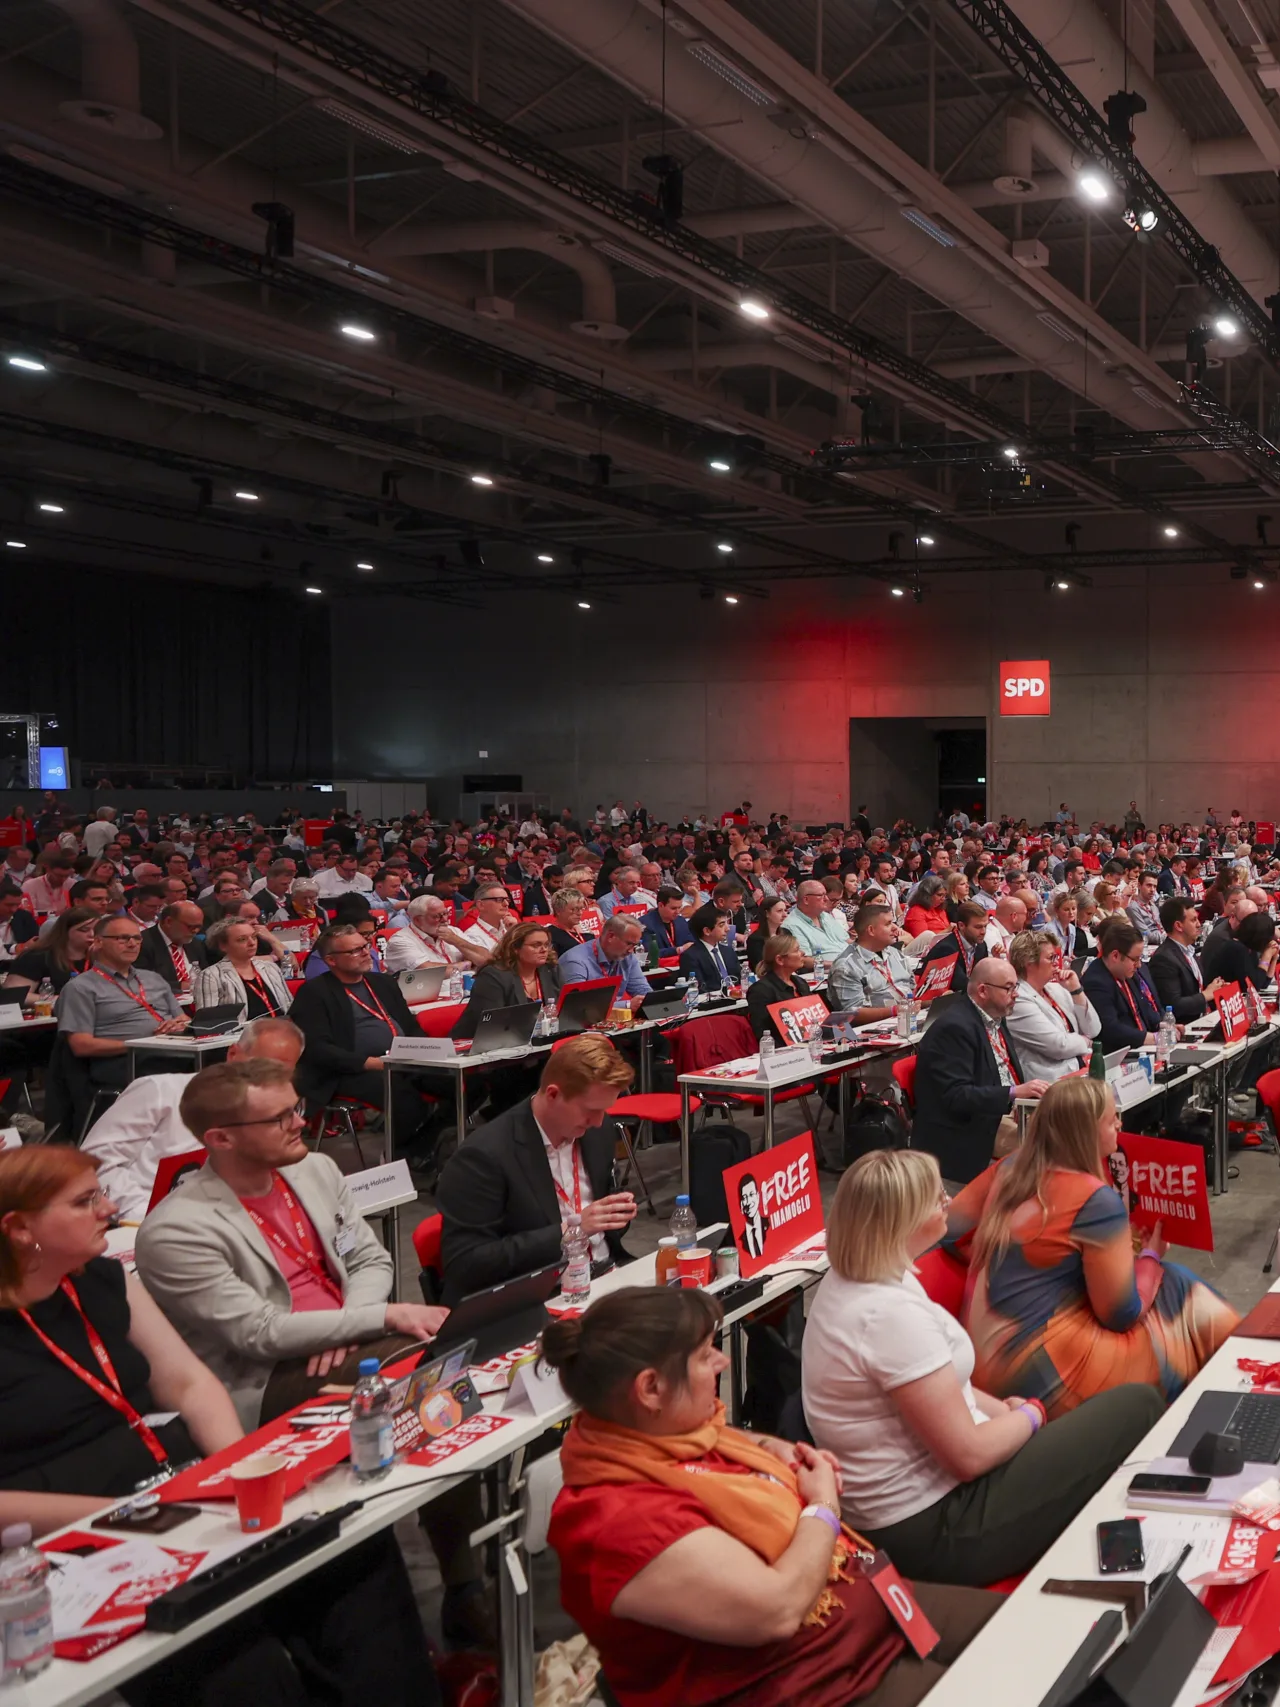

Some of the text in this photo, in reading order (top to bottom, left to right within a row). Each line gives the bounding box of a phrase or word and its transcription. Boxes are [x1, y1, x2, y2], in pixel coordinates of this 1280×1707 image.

[1004, 678, 1045, 697] SPD
[931, 962, 955, 984] FREE
[794, 1002, 826, 1026] FREE
[1226, 991, 1243, 1017] FREE
[761, 1152, 810, 1216] FREE
[1132, 1160, 1197, 1197] FREE
[770, 1194, 811, 1230] IMAMOGLU
[1140, 1194, 1196, 1221] IMAMOGLU
[888, 1584, 913, 1622] D
